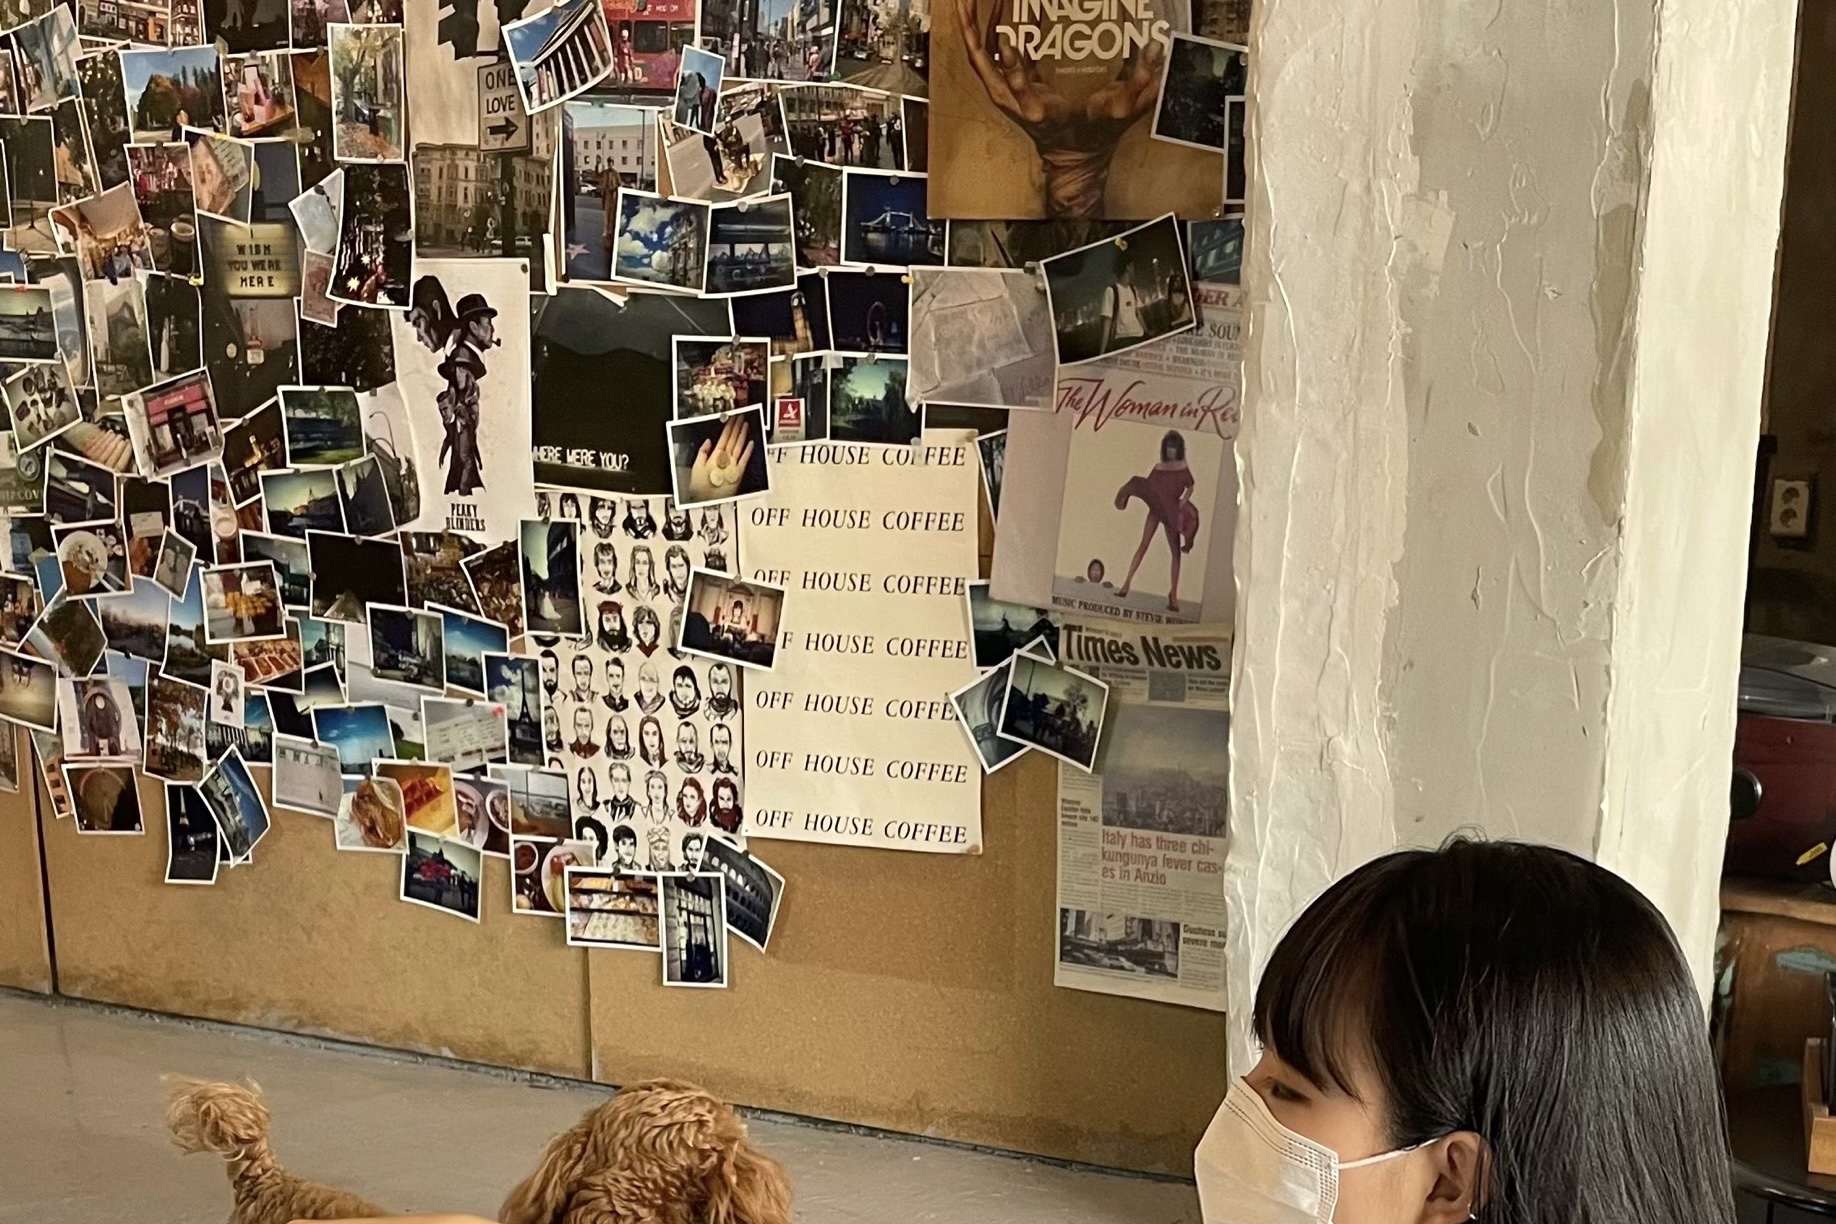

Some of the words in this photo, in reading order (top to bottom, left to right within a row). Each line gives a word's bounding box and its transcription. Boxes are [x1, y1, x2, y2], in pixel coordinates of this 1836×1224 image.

[1012, 0, 1154, 23] IMAGINE
[995, 20, 1170, 61] DRAGONS
[485, 68, 518, 90] ONE
[486, 94, 516, 115] LOVE
[226, 259, 248, 271] YOU
[250, 259, 282, 271] WERE
[239, 275, 275, 288] HERE
[1056, 385, 1084, 414] The
[1058, 377, 1179, 432] Woman
[1180, 402, 1199, 418] in
[531, 445, 563, 464] HERE
[566, 448, 596, 468] WERE
[599, 452, 630, 470] YOU?
[799, 445, 871, 465] HOUSE
[450, 502, 478, 518] PEAKY
[751, 507, 791, 527] OFF
[801, 508, 871, 529] HOUSE
[882, 511, 965, 532] COFFEE
[445, 516, 486, 532] BLINDERS
[753, 568, 791, 587] OFF
[801, 571, 872, 592] HOUSE
[883, 574, 966, 596] COFFEE
[1051, 595, 1077, 609] MUSIC
[1077, 600, 1121, 617] PRODUCED
[1122, 608, 1134, 619] BY
[805, 633, 875, 654] HOUSE
[886, 637, 969, 659] COFFEE
[1062, 623, 1141, 667] Times
[1139, 635, 1222, 671] News
[756, 690, 794, 710] OFF
[803, 693, 874, 716] HOUSE
[885, 699, 960, 722] COFFE
[756, 750, 794, 770] OFF
[803, 753, 875, 776] HOUSE
[886, 760, 968, 784] COFFEE
[756, 808, 794, 829] OFF
[803, 813, 874, 836] HOUSE
[884, 820, 968, 844] COFFEE
[1101, 829, 1127, 849] Italy
[1131, 833, 1153, 849] has
[1155, 836, 1187, 853] three
[1190, 839, 1215, 856] chi-
[1101, 846, 1159, 870] kungunya
[1162, 854, 1193, 872] fever
[1101, 866, 1116, 879] es
[1119, 867, 1131, 881] in
[1134, 869, 1167, 885] Anzio
